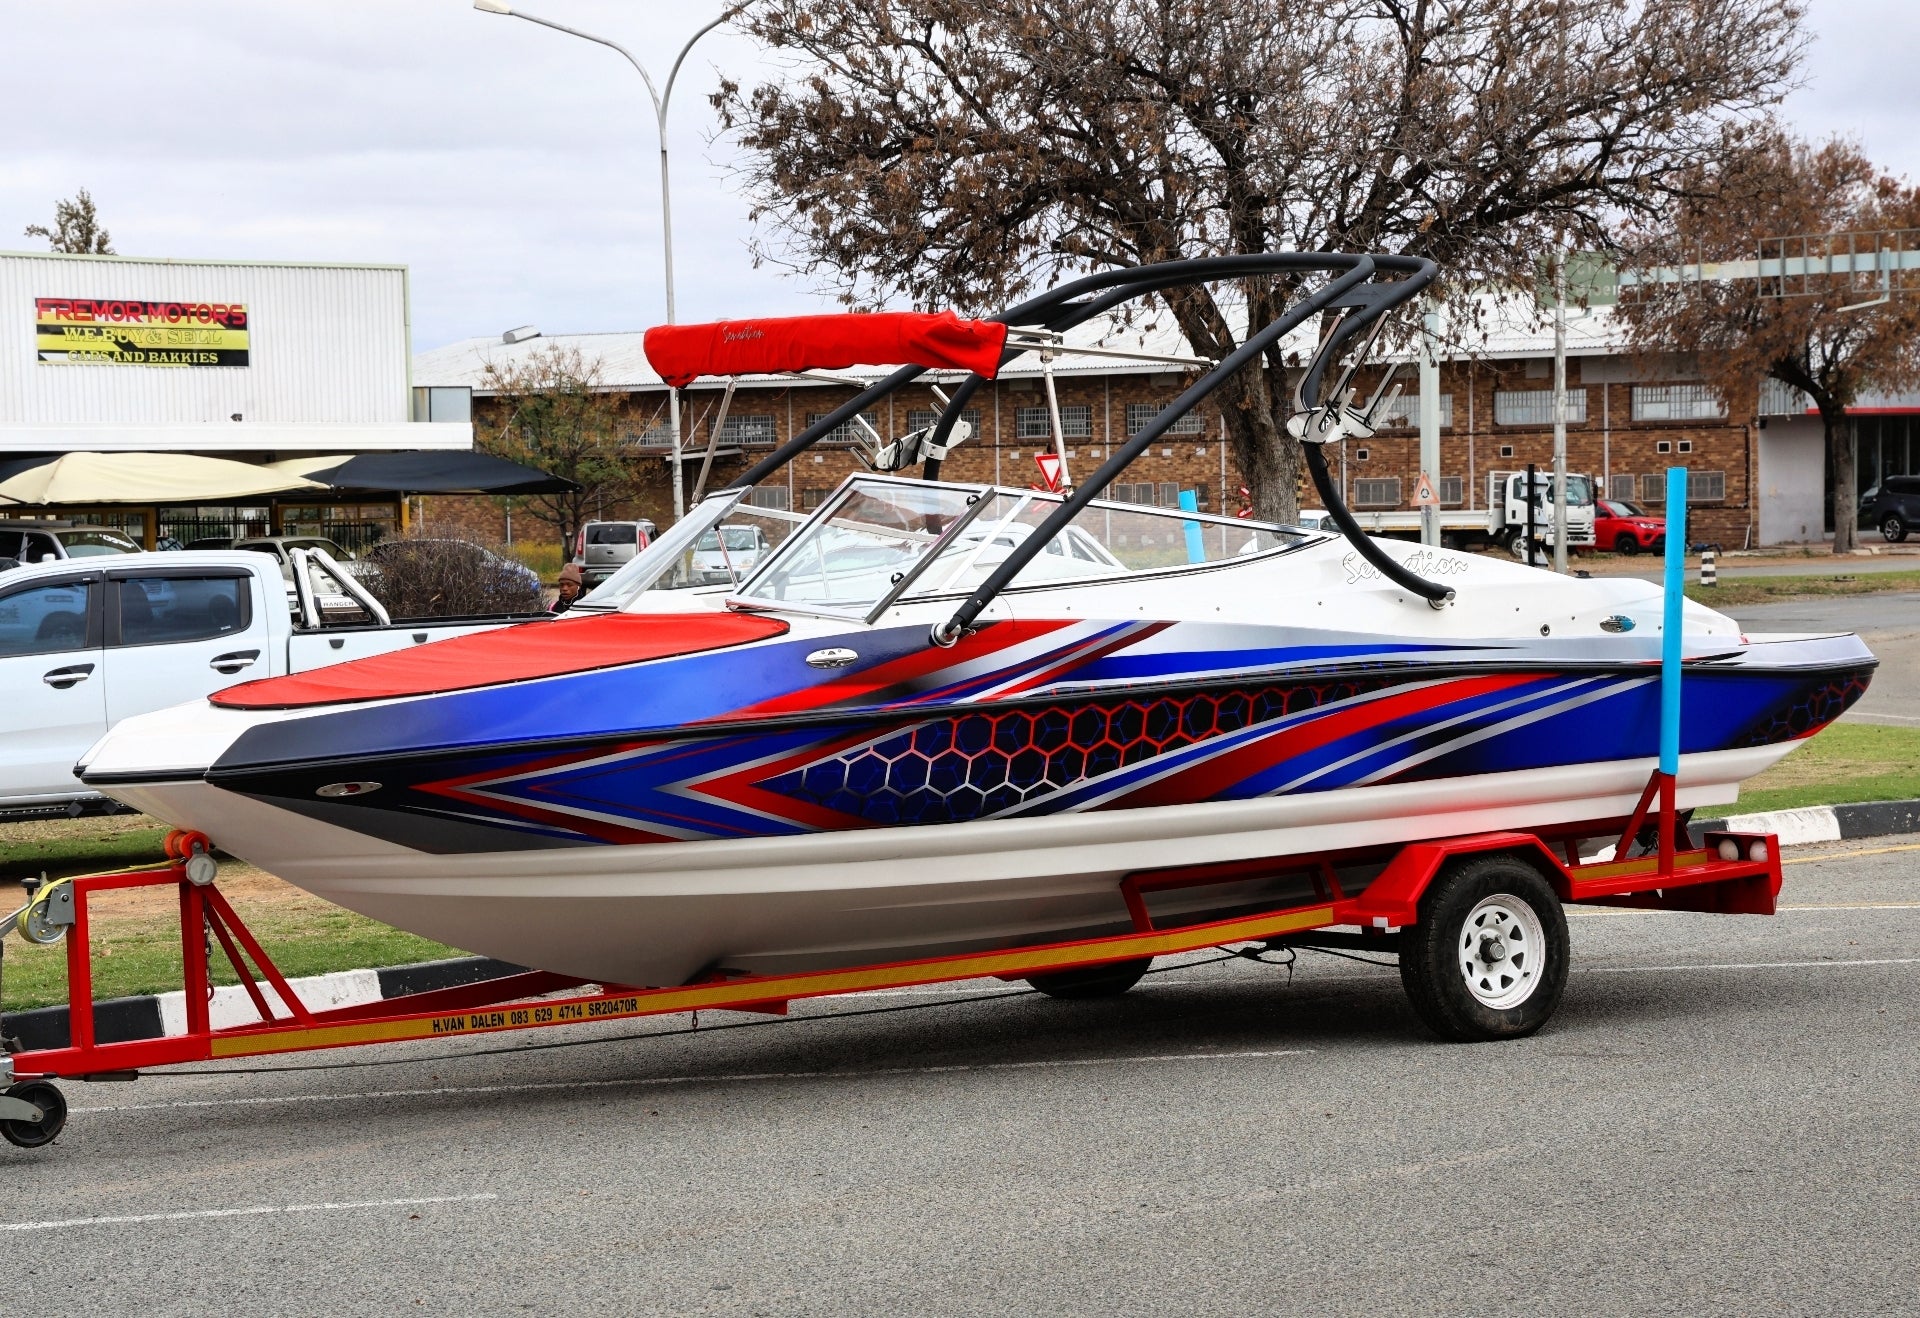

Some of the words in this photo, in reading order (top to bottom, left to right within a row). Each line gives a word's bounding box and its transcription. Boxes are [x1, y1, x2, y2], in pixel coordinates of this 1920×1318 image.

[36, 299, 144, 323] FREMOR
[148, 303, 247, 325] MOTORS
[62, 327, 101, 343] WE
[102, 327, 144, 344] BUY
[146, 330, 162, 345] &
[167, 328, 223, 345] SELL
[68, 350, 111, 363] CARS
[113, 350, 145, 363] AND
[149, 351, 219, 364] BAKKIES
[432, 1016, 465, 1033] H.VAN
[471, 1012, 505, 1029] DALEN
[511, 1010, 529, 1025] 083
[535, 1008, 553, 1023] 629
[558, 1004, 583, 1019] 4714
[588, 998, 638, 1016] SR20470R
